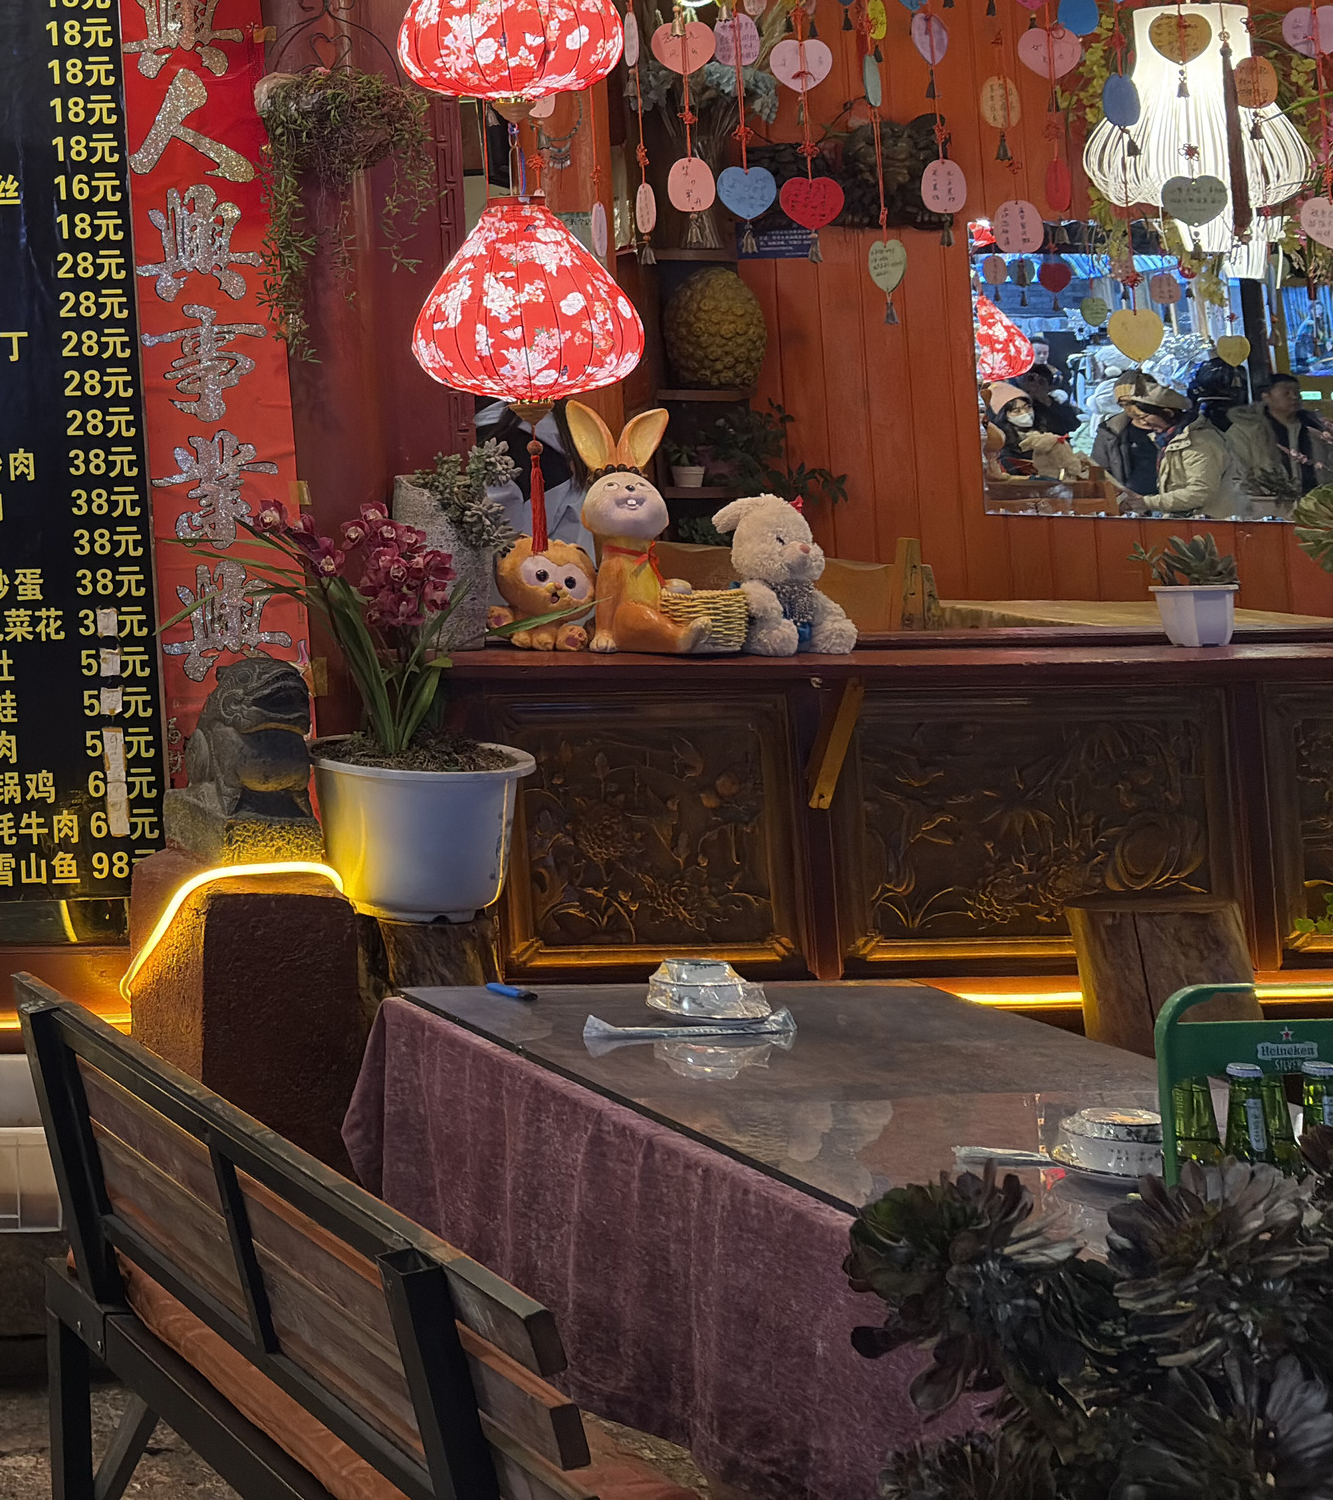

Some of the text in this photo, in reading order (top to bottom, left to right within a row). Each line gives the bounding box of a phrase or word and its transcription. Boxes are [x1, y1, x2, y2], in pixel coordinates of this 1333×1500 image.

[45, 17, 113, 48] 18元
[47, 56, 115, 87] 18元
[49, 94, 117, 125] 18元
[52, 133, 120, 164] 18元
[54, 172, 122, 203] 16元
[56, 211, 125, 242] 18元
[56, 250, 126, 280] 28元
[59, 289, 129, 320] 28元
[61, 328, 131, 359] 28元
[63, 367, 134, 399] 28元
[66, 407, 136, 438] 28元
[68, 446, 139, 478] 38元
[71, 486, 141, 518] 38元
[73, 526, 144, 558] 38元
[75, 566, 146, 598] 38元
[78, 606, 148, 639] 3元
[81, 646, 151, 678] 5元
[83, 687, 153, 718] 5元
[88, 768, 157, 799] 6元
[90, 808, 159, 840] 6元
[92, 850, 156, 879] 98
[1261, 1046, 1314, 1056] Heineken
